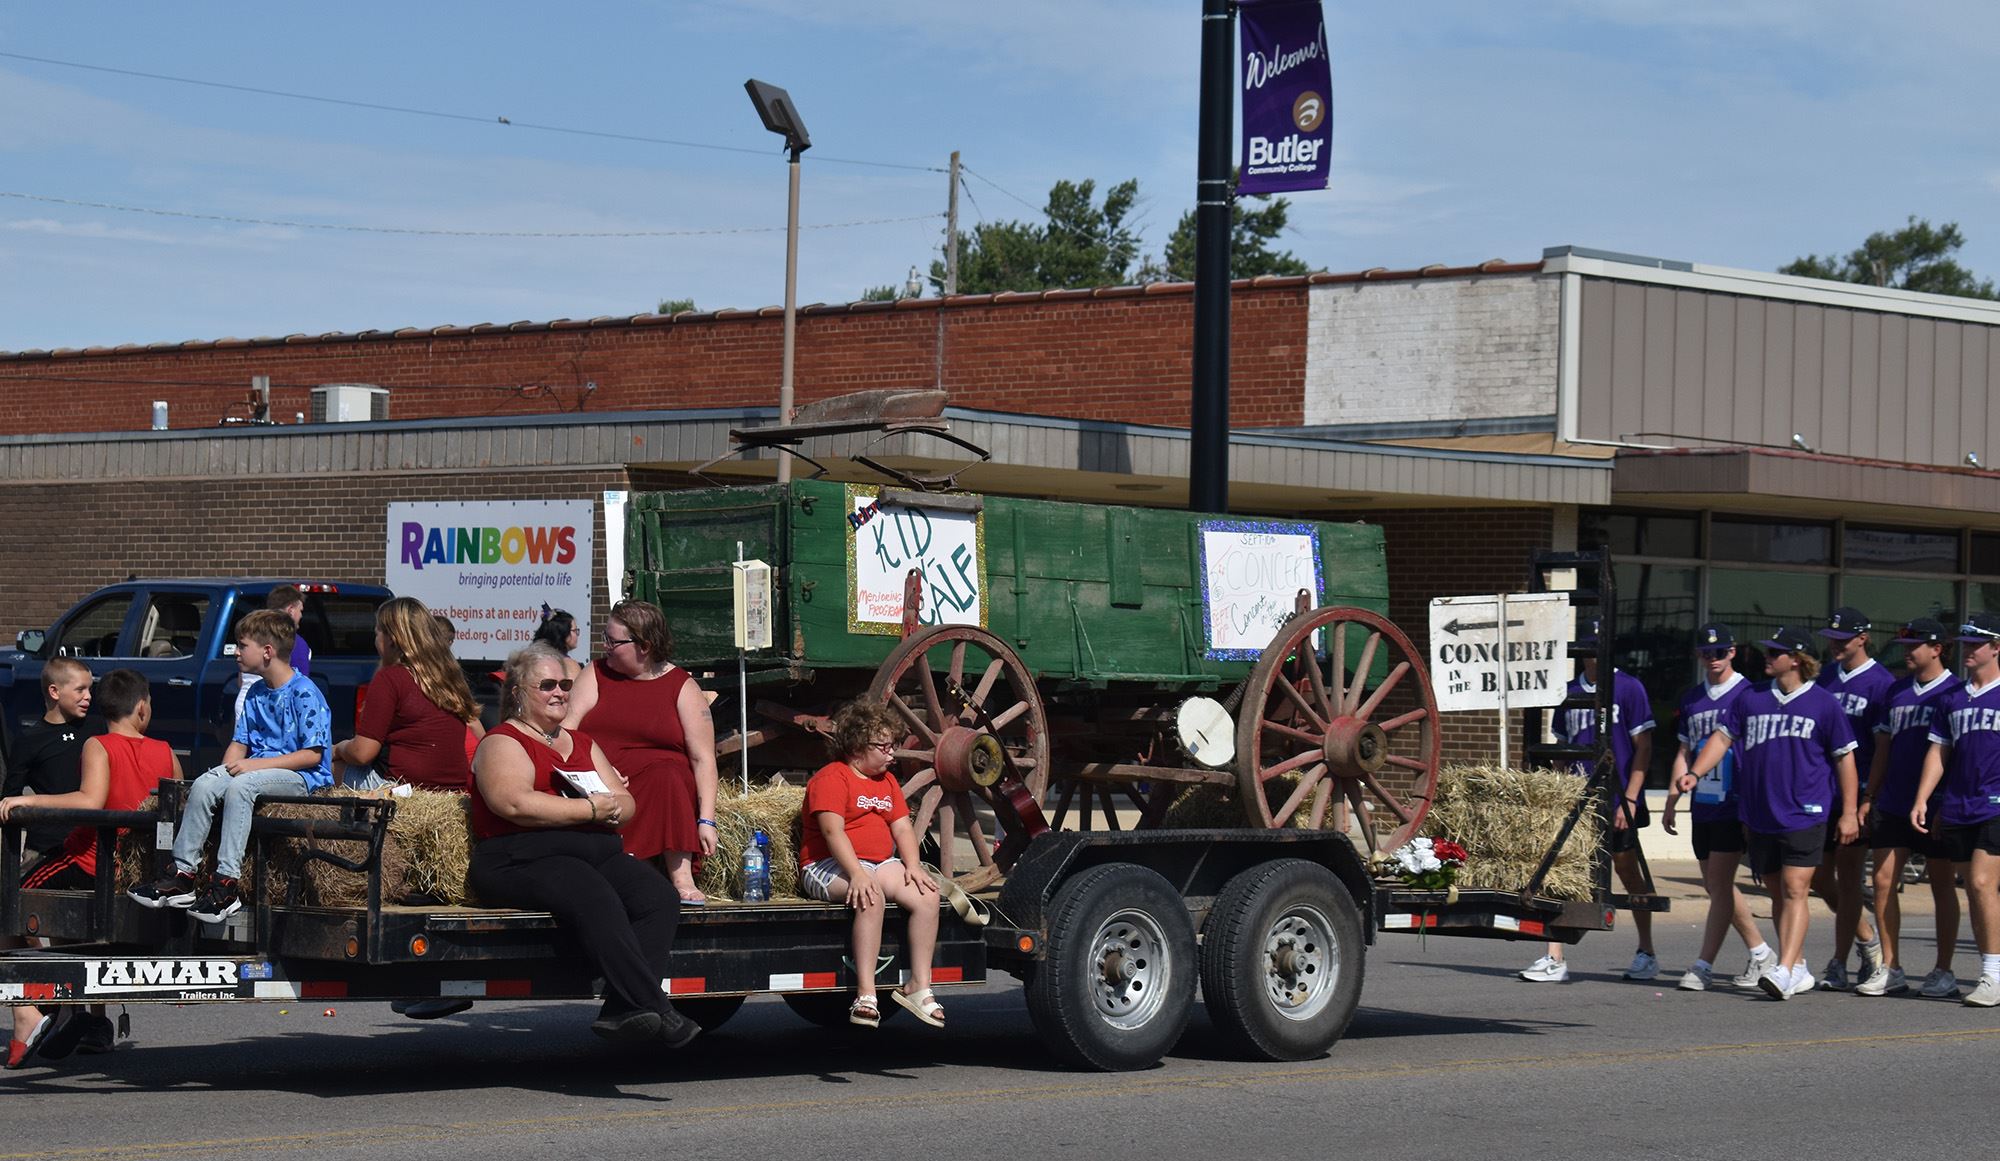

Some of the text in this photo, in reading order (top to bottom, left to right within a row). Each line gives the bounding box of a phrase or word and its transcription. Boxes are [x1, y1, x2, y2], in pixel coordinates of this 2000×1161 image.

[1246, 22, 1326, 90] Welcome!
[1249, 134, 1323, 165] Butler
[1248, 163, 1317, 175] Community College
[401, 521, 576, 570] RAINBOWS
[872, 507, 932, 573] KID
[459, 571, 572, 589] bringing potential to life
[1227, 550, 1314, 592] CONCERT
[450, 605, 483, 622] begins
[485, 607, 495, 619] at
[497, 609, 510, 619] an
[512, 606, 538, 623] early
[455, 628, 537, 643] ted.org Call 316.
[1439, 640, 1557, 665] CONCERT
[1448, 681, 1471, 694] THE
[1449, 670, 1461, 681] IN
[1745, 713, 1816, 751] BUTLER
[84, 961, 238, 994] LAMAR
[179, 991, 235, 999] Trailers Inc
